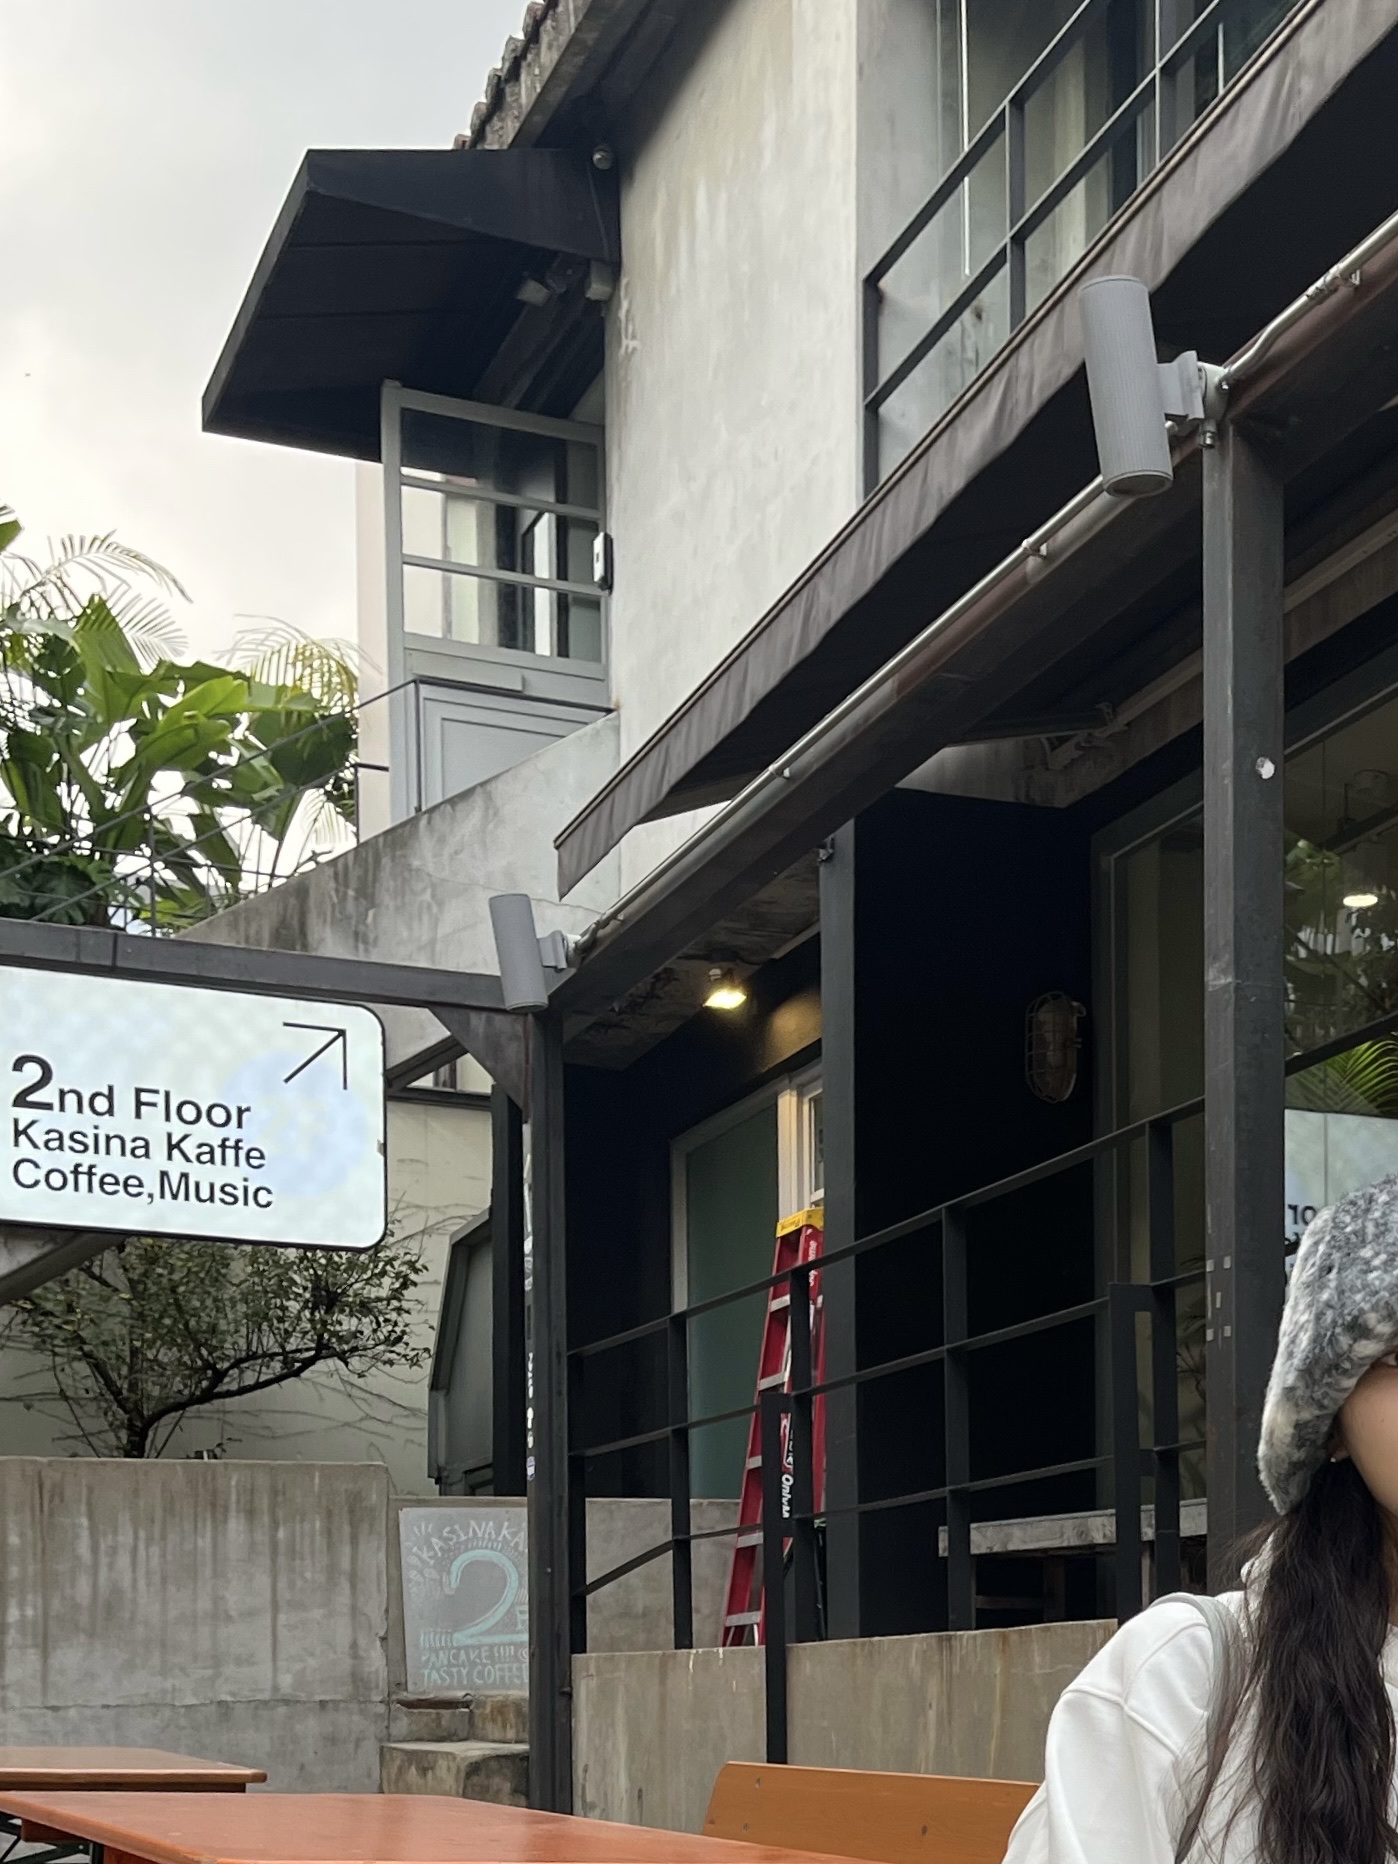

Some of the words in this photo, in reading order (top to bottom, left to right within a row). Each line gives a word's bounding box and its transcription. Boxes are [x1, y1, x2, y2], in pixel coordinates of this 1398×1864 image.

[11, 1054, 115, 1118] 2nd
[134, 1086, 252, 1130] Floor
[13, 1117, 151, 1160] Kasina
[166, 1131, 266, 1170] Kaffe
[12, 1157, 274, 1209] Coffee,Music
[421, 1667, 469, 1688] TASTY
